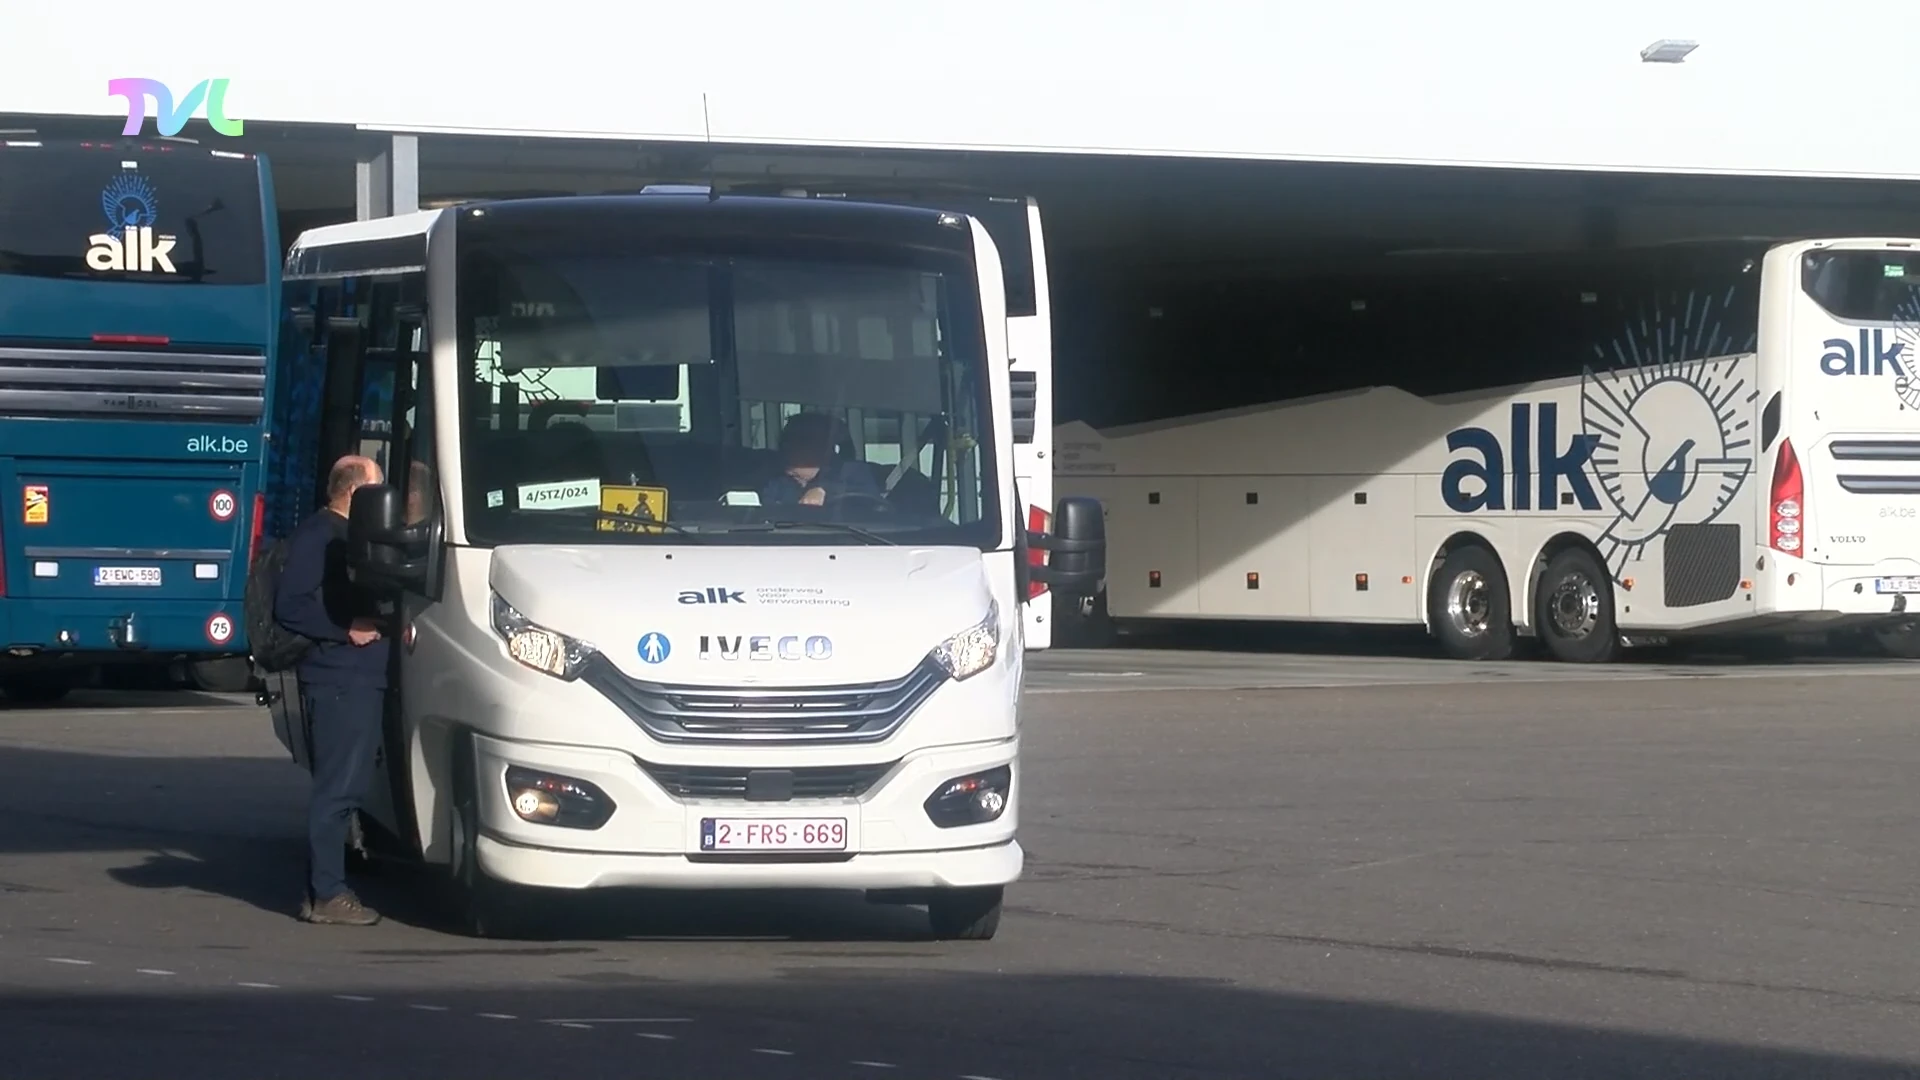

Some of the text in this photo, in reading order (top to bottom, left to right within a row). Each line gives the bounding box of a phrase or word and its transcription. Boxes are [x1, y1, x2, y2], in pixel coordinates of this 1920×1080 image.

[86, 226, 177, 273] alk
[1820, 328, 1905, 376] alk
[187, 435, 248, 452] alk.be
[1441, 402, 1602, 513] alk
[526, 487, 588, 502] 4/STZ/024
[214, 499, 232, 511] 100
[677, 587, 747, 605] alk
[756, 587, 824, 595] onderweg
[759, 598, 850, 606] verwondering
[213, 623, 228, 634] 75
[698, 635, 833, 661] IVECO
[718, 824, 844, 844] 2-FRS-669
